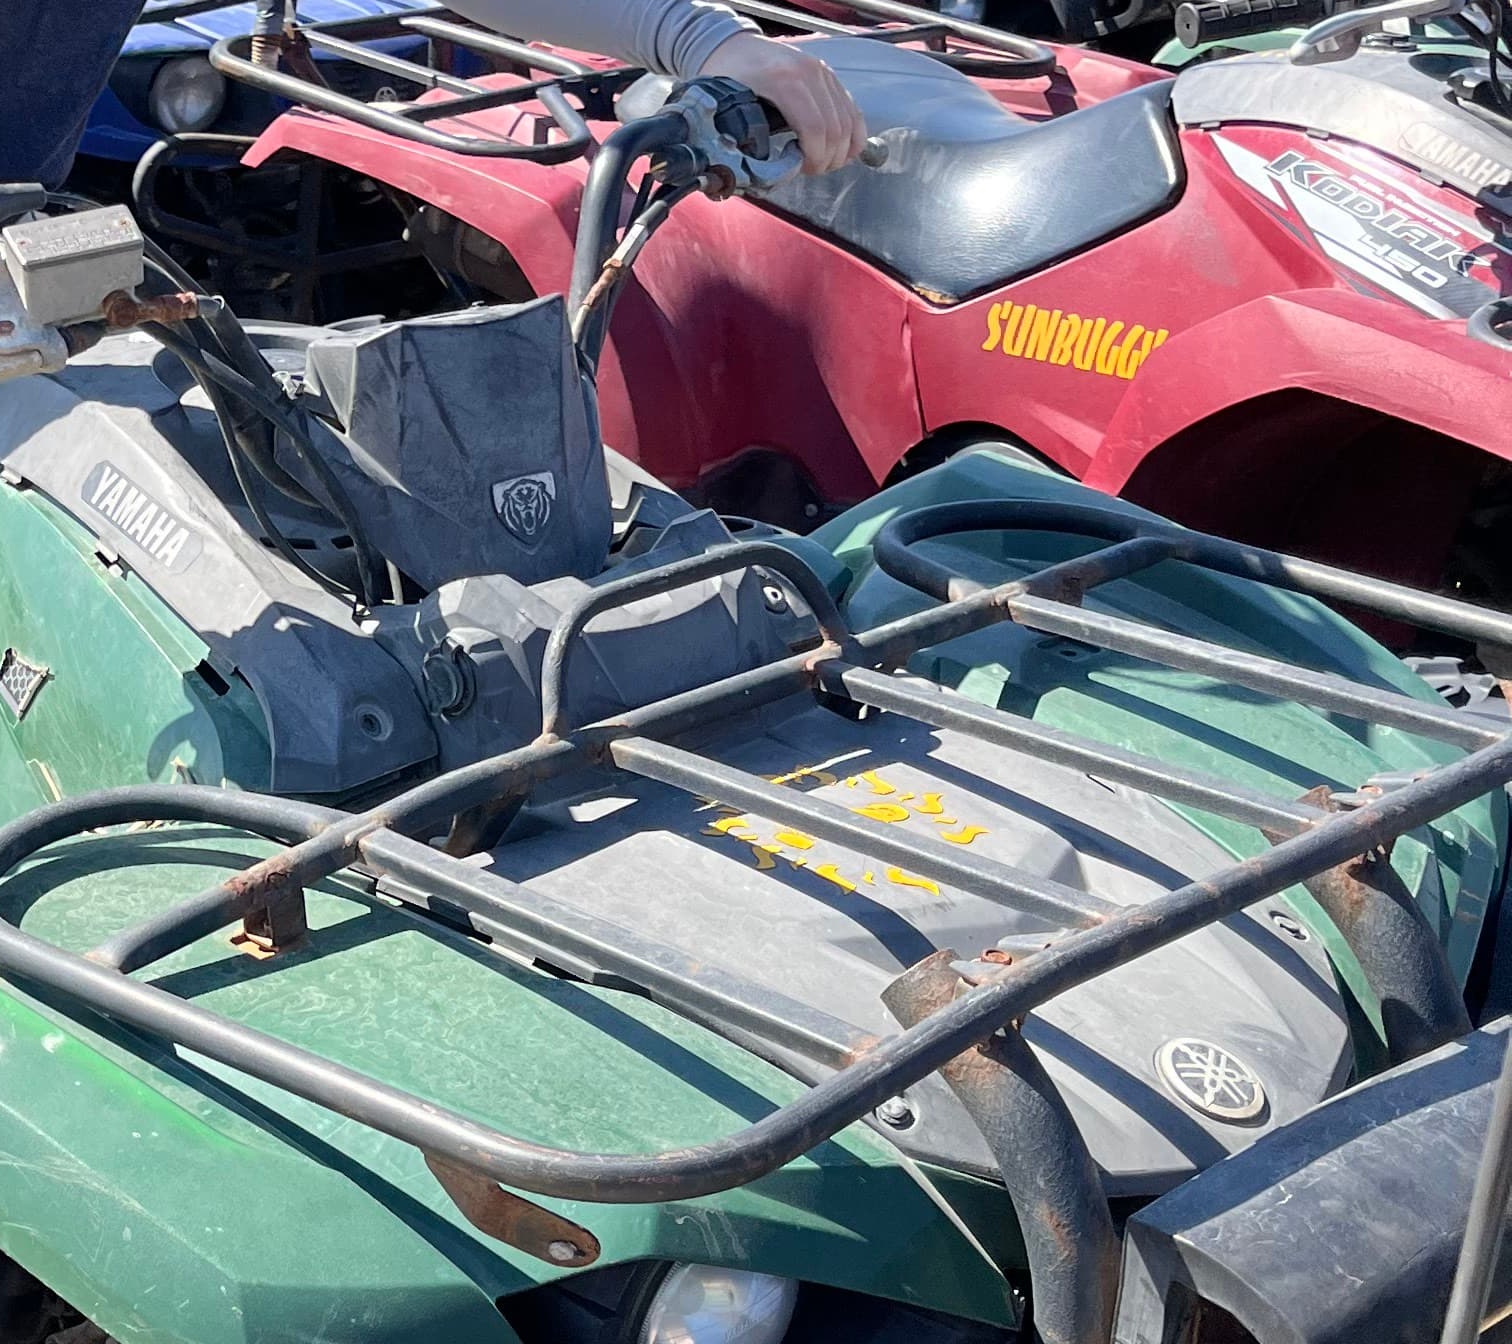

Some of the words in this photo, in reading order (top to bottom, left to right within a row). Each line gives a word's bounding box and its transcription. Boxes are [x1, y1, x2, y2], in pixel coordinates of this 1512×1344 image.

[1264, 150, 1491, 278] KODIAK
[1357, 233, 1449, 289] 450
[90, 465, 190, 568] YAMAHA
